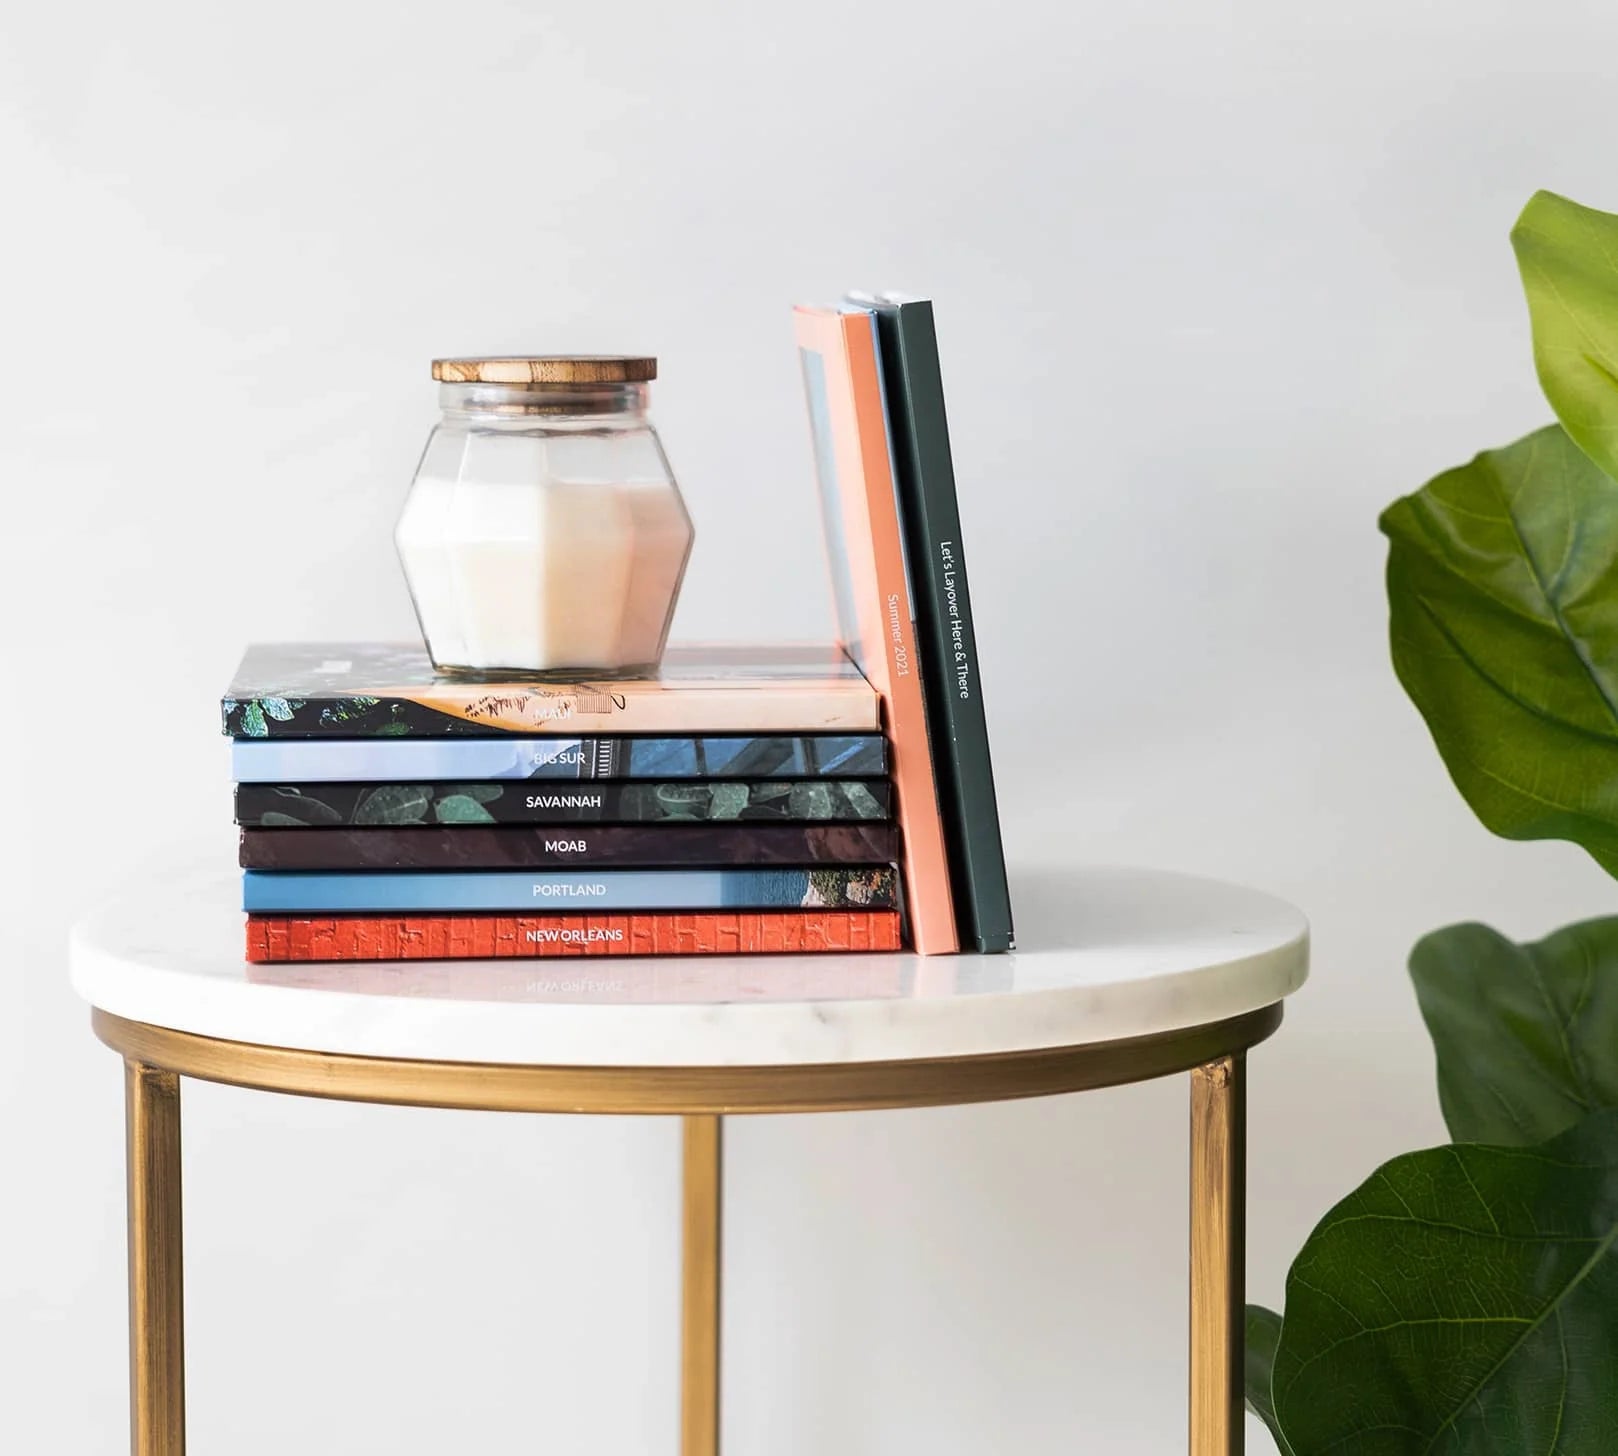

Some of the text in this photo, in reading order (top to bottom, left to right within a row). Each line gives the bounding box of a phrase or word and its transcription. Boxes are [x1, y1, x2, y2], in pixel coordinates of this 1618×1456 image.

[940, 541, 969, 699] Let's Layover Here & There
[888, 594, 909, 677] Summer 2021
[534, 709, 572, 720] MAUI
[534, 752, 586, 764] BIG SUR
[526, 796, 601, 808] SAVANNAH
[545, 840, 587, 852] MOAB
[532, 884, 607, 897] PORTLAND
[526, 929, 623, 942] NEW ORLEANS
